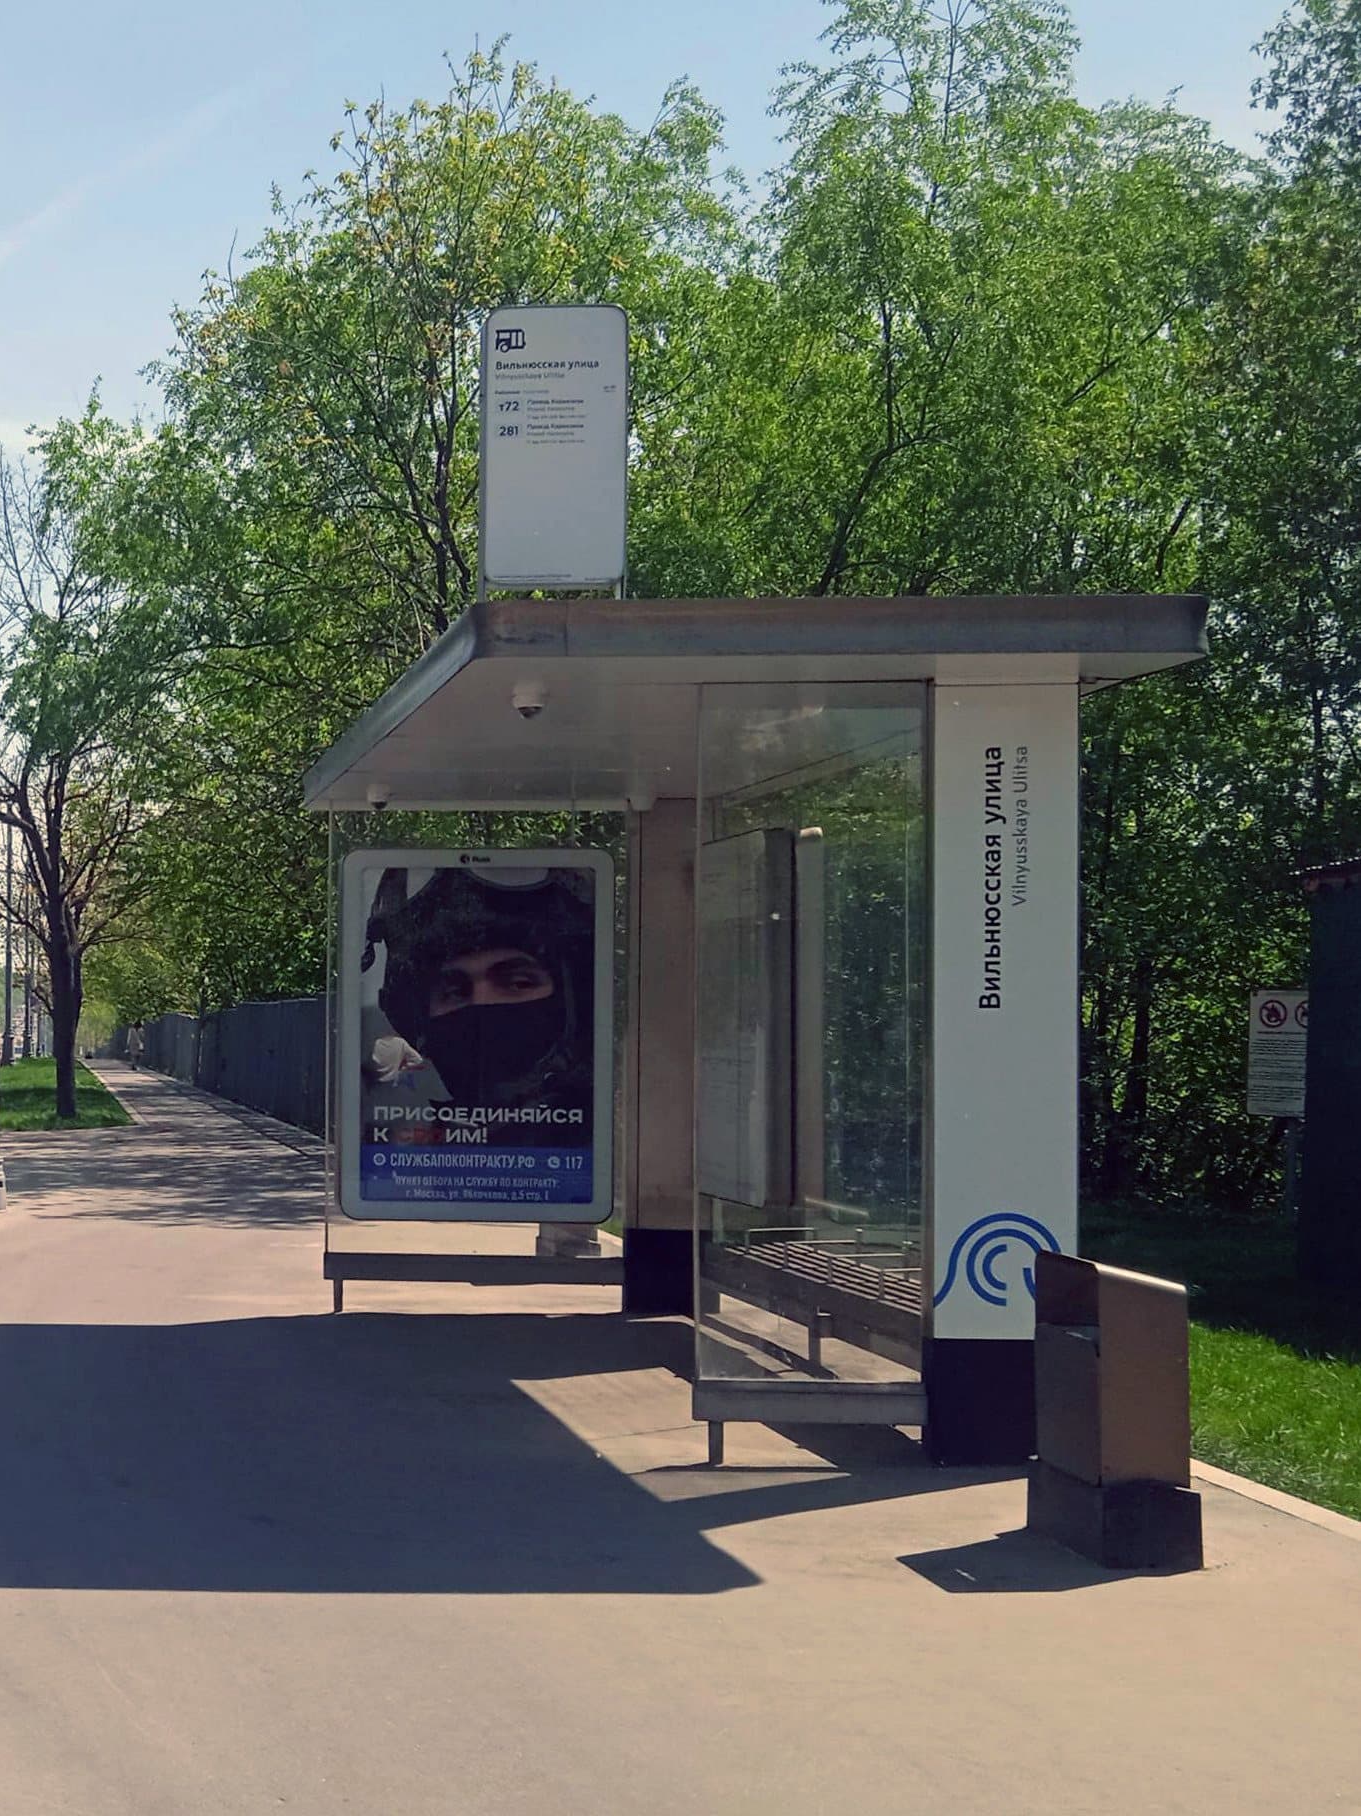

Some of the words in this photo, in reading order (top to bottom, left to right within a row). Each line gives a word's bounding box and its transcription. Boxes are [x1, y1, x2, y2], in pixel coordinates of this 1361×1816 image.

[495, 361, 566, 370] Вильнюсская
[567, 360, 600, 370] улица
[499, 425, 519, 437] 281
[1012, 746, 1029, 793] Ulitsa
[985, 746, 1006, 825] улица
[1012, 799, 1031, 907] Vilnyusskaya
[978, 833, 1001, 1009] Вильнюсская
[373, 1104, 583, 1126] ПРИСОЕДИНЯЙСЯ
[373, 1127, 389, 1143] К
[396, 1127, 488, 1144] ИМ!
[390, 1152, 535, 1169] СЛУЖБАПОКОНТРАКТУ.РФ
[565, 1155, 583, 1169] 117
